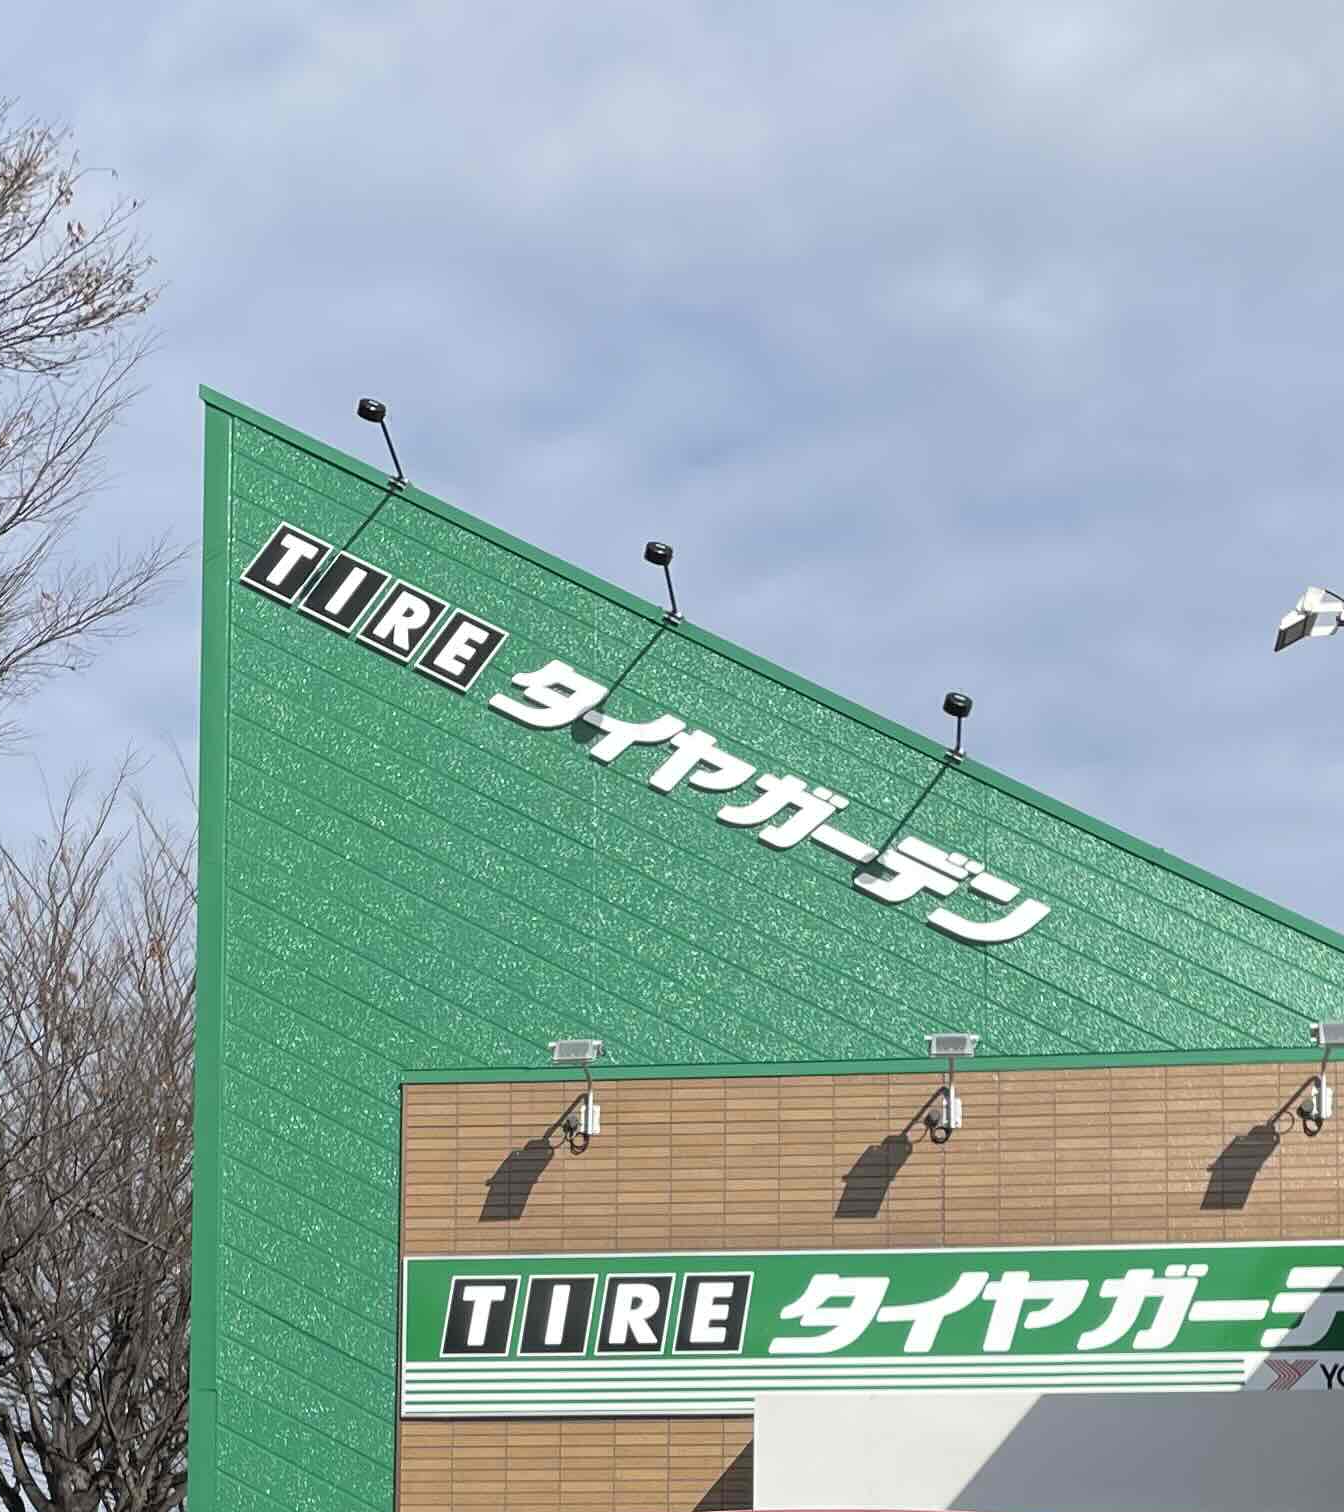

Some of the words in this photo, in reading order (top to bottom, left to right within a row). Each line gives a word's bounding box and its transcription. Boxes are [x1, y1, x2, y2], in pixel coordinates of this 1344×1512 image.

[262, 530, 488, 678] TIRE
[488, 658, 1052, 945] タイヤガーデン
[461, 1281, 735, 1347] TIRE
